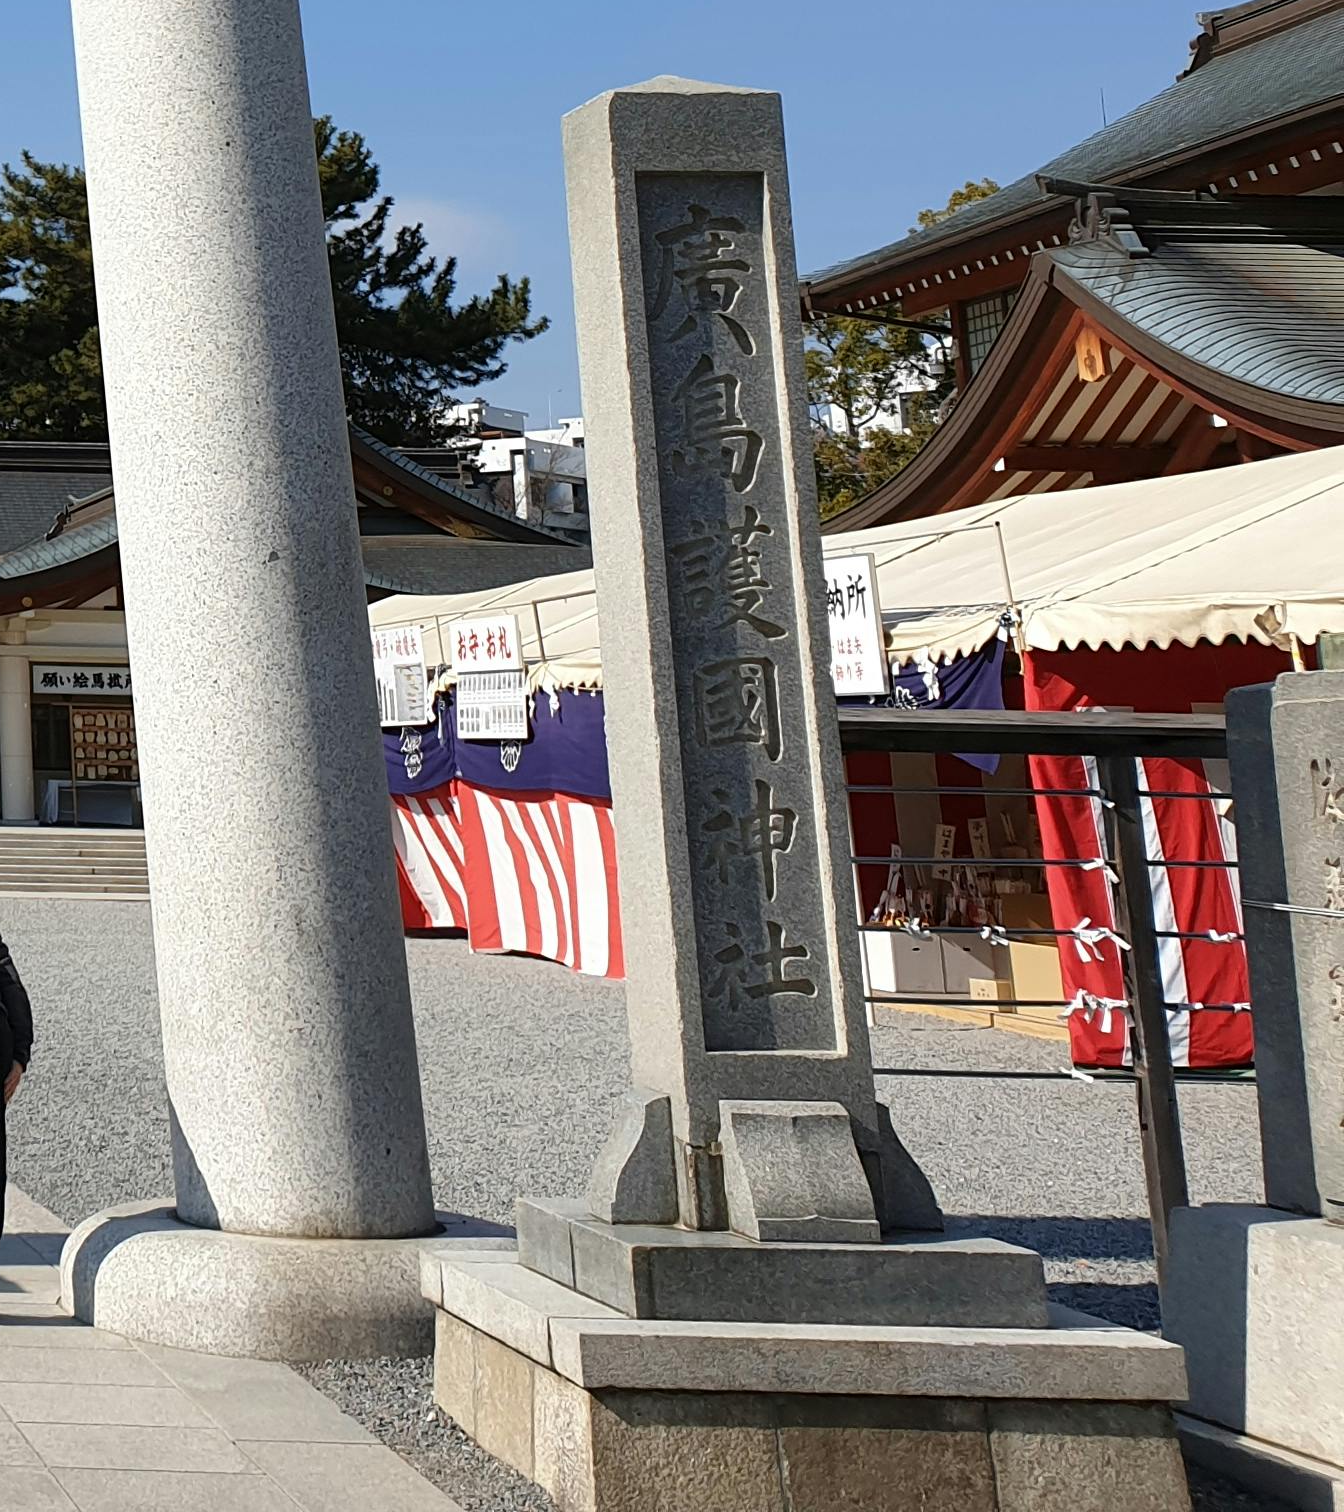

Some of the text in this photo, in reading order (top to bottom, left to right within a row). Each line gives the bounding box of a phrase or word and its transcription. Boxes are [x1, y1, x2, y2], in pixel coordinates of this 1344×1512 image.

[647, 202, 817, 1012] 廣島護國神社
